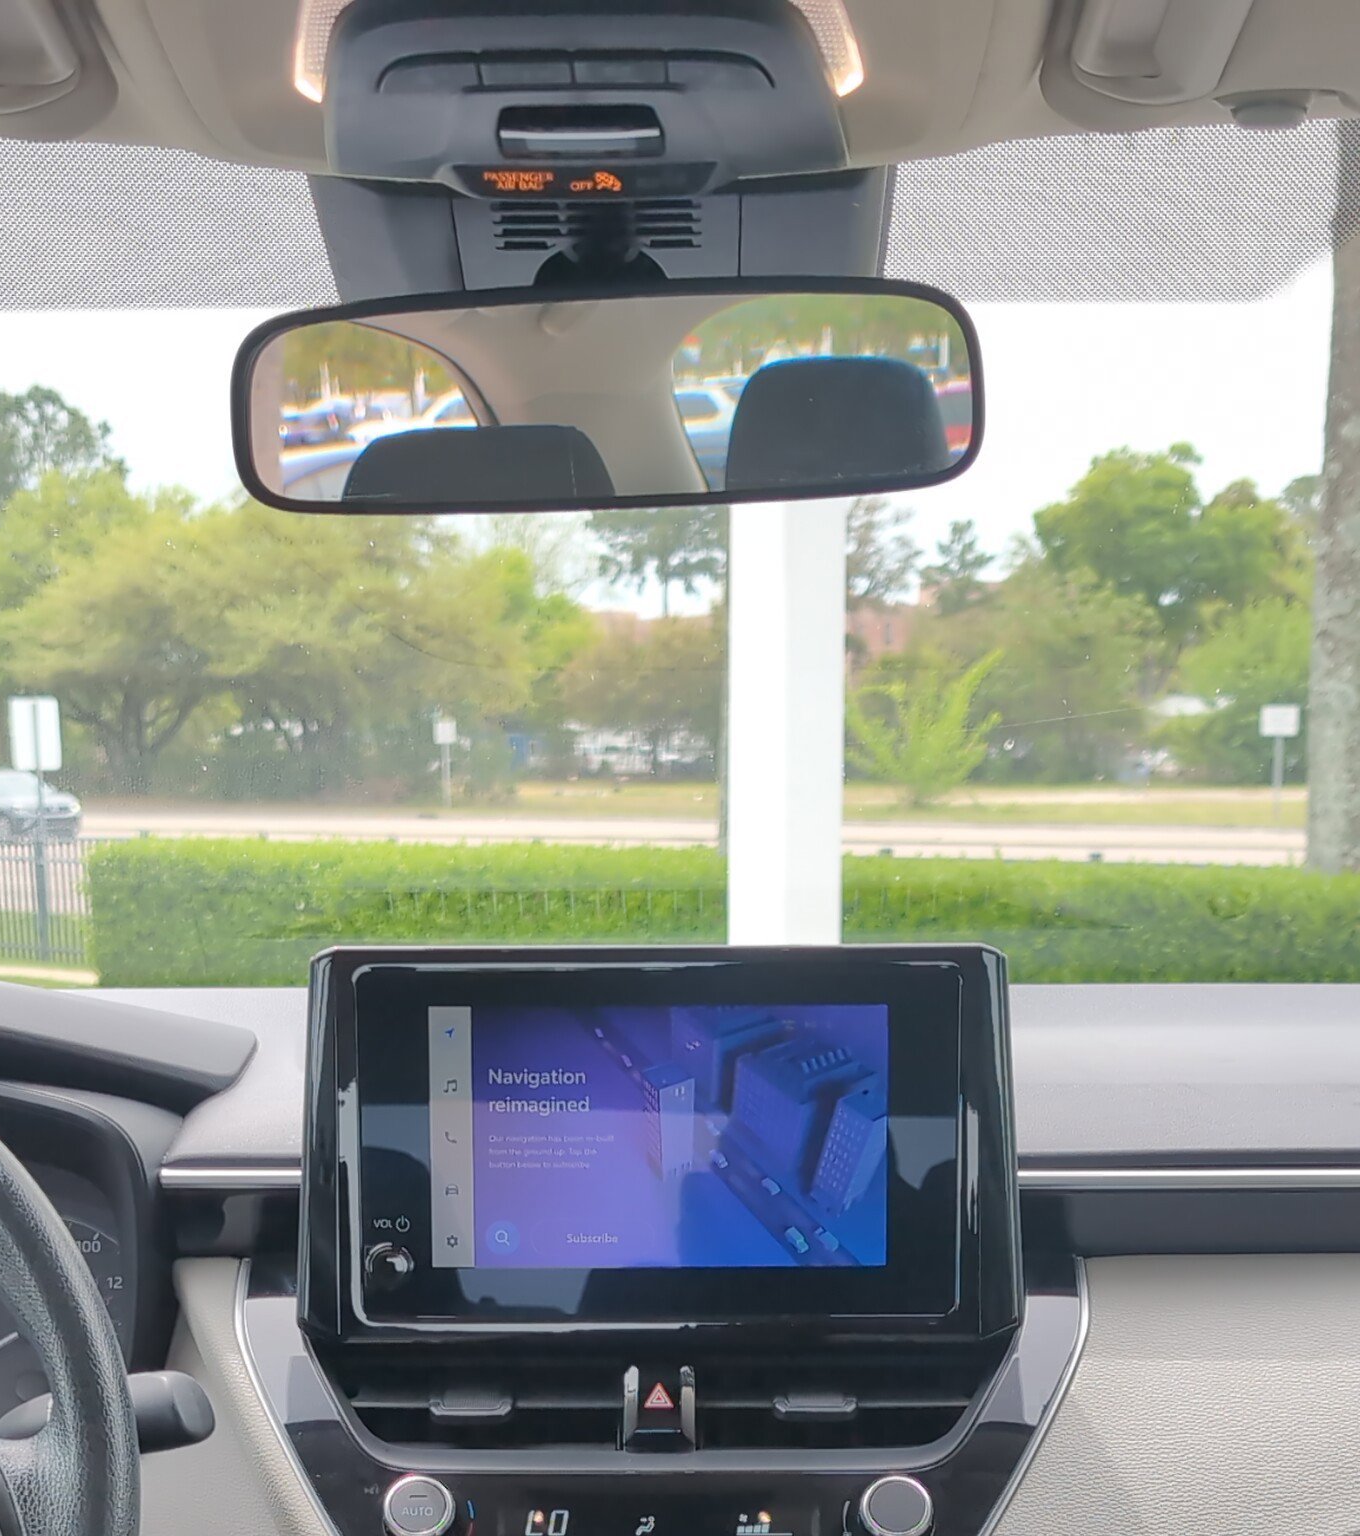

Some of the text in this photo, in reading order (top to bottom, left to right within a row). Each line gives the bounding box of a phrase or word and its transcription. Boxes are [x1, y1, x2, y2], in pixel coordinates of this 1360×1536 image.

[483, 171, 554, 182] PASSENGER
[497, 180, 593, 191] AIR BAG OFF
[488, 1068, 586, 1089] Navigation
[488, 1096, 591, 1117] reimagined
[373, 1218, 393, 1229] VOL
[566, 1232, 619, 1244] Subscribe
[401, 1506, 434, 1517] AUTO
